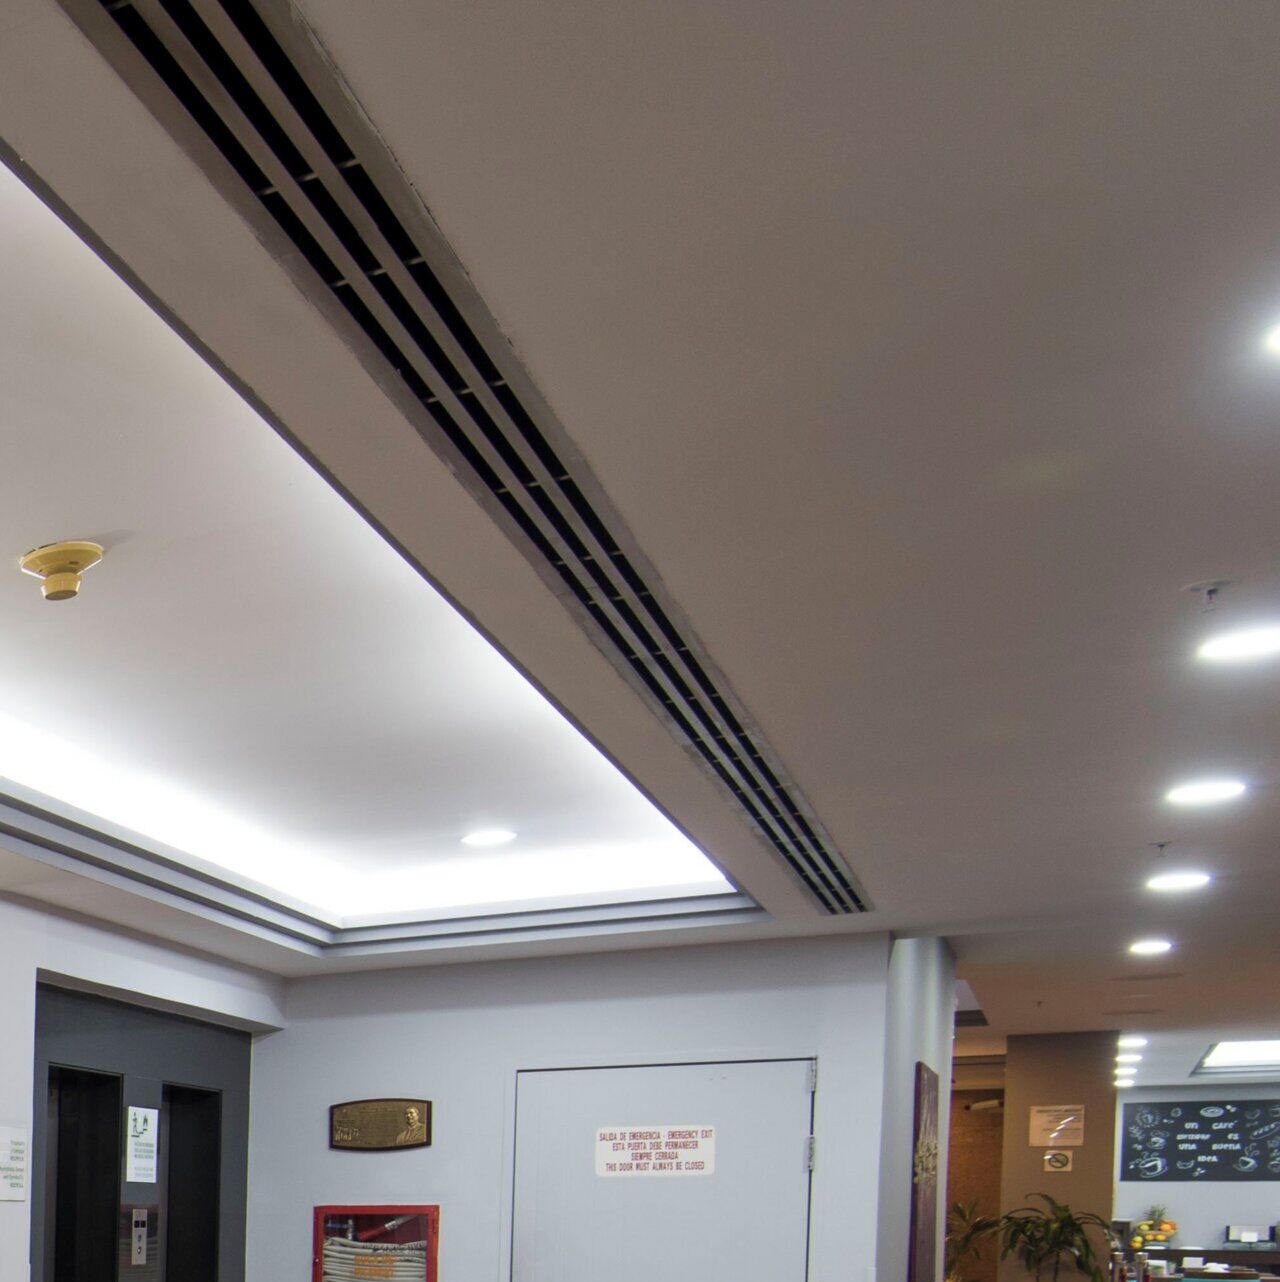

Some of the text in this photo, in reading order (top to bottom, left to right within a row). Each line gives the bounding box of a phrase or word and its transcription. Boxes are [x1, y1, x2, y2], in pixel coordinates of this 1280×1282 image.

[599, 1129, 713, 1141] SALIDA DE EMERGENCIA EMERGENCY EXIT
[612, 1140, 698, 1151] ESTA PUERTA DEBE PERMANECER
[631, 1151, 678, 1161] SIEMPRE CERRADA
[606, 1160, 705, 1171] THIS DOOR MUST ALWAYS BE CLOSED
